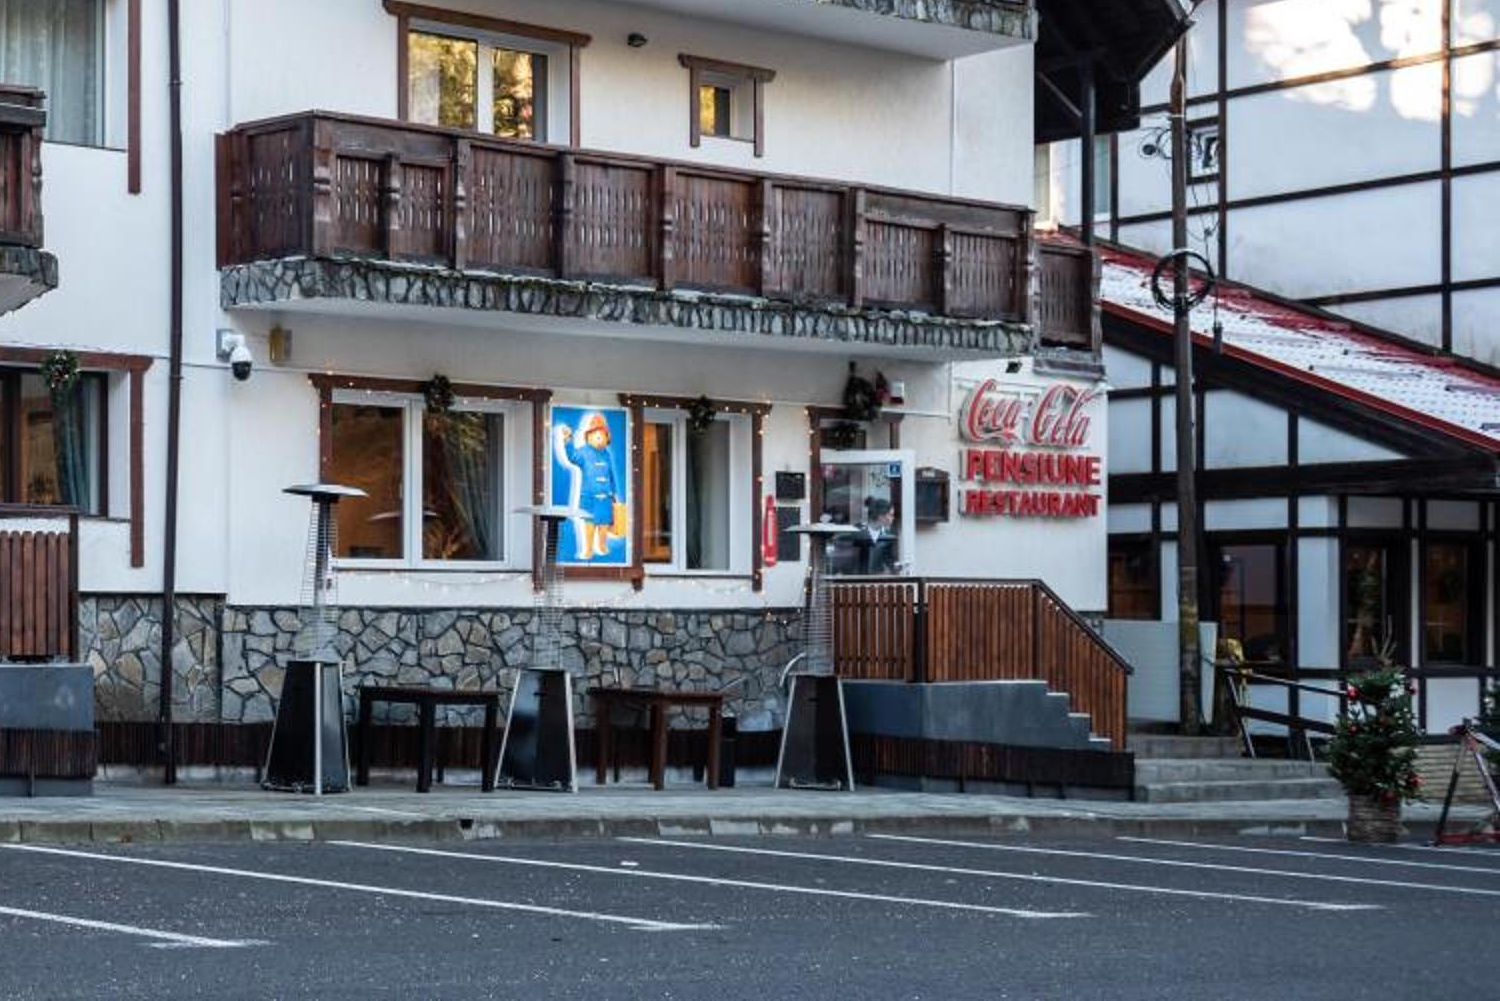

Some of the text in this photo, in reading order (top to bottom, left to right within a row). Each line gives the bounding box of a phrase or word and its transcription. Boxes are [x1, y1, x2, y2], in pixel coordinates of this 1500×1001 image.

[967, 378, 1094, 445] Coca-Cola
[966, 448, 1102, 486] PENSIUNE
[964, 489, 1102, 517] RESTAURANT
